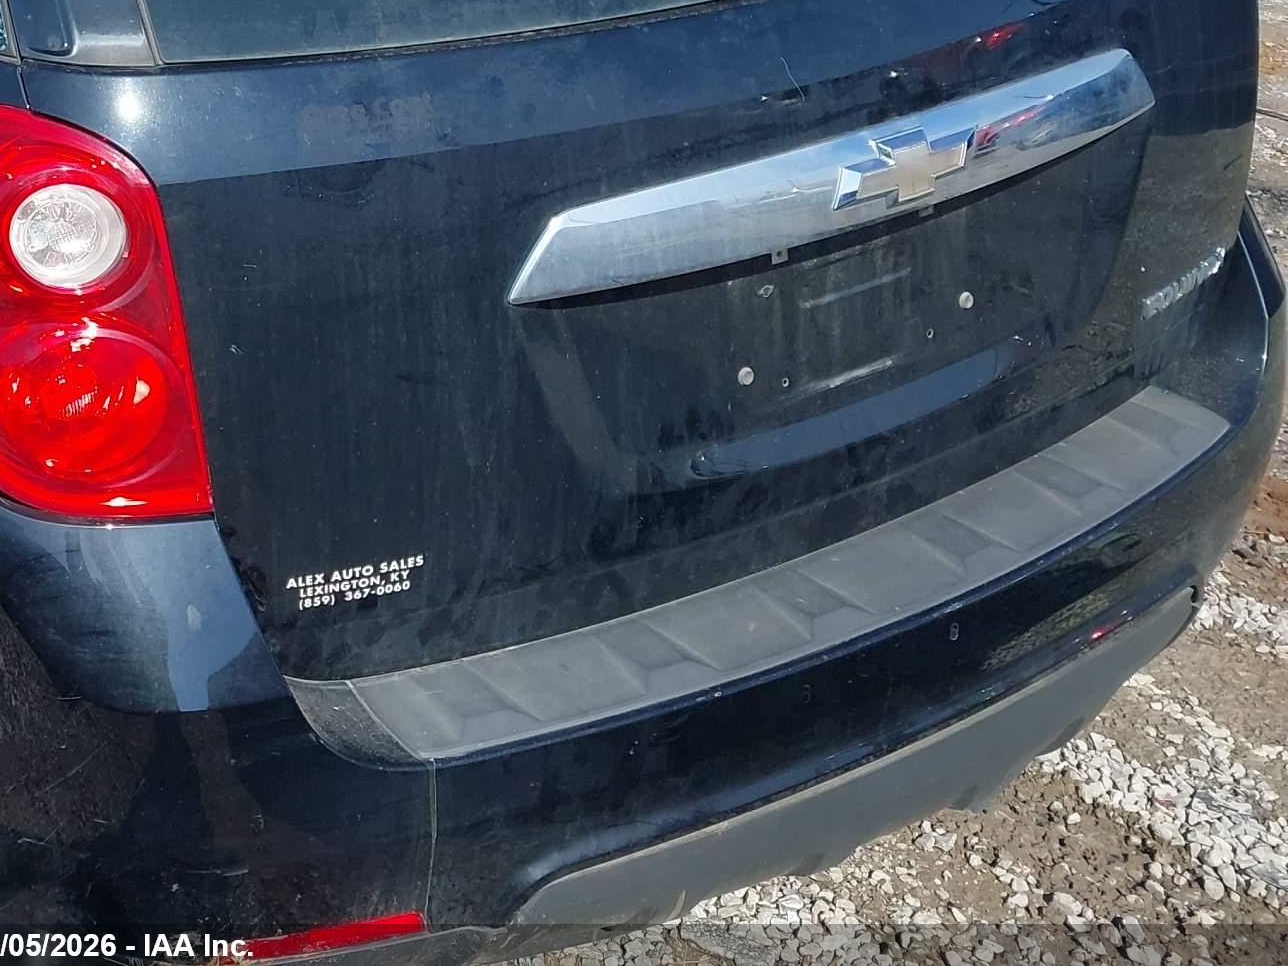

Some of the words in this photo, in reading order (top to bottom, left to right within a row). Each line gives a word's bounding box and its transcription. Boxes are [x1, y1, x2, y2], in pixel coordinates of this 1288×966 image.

[286, 573, 325, 589] ALEX
[331, 565, 374, 582] AUTO
[380, 554, 424, 573] SALES
[300, 575, 386, 598] LEXINGTON,
[391, 570, 410, 582] KY
[299, 594, 336, 610] (859)
[345, 581, 411, 601] 367-0060
